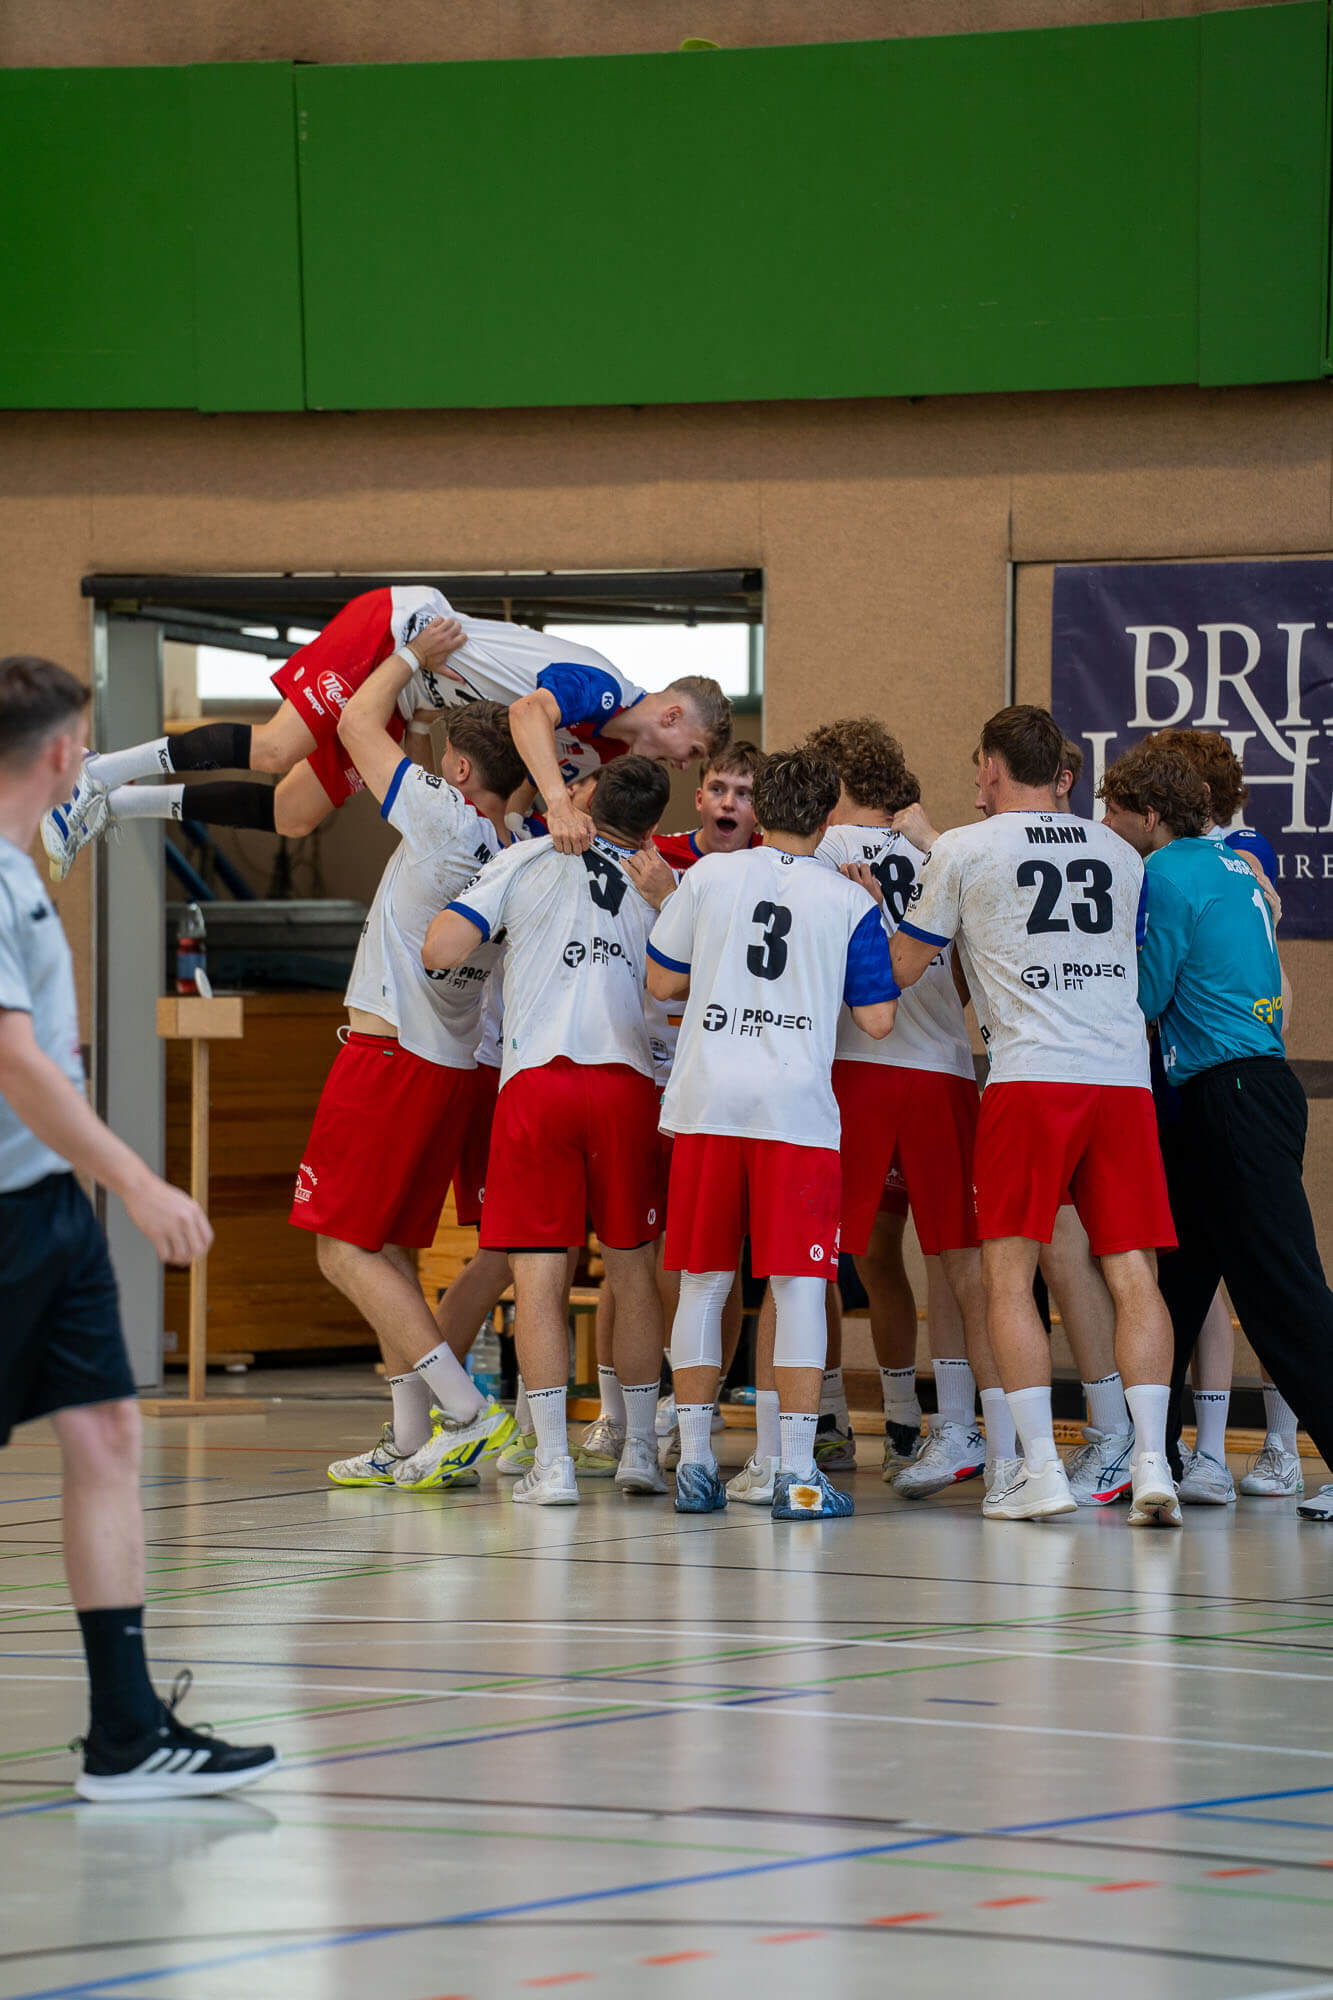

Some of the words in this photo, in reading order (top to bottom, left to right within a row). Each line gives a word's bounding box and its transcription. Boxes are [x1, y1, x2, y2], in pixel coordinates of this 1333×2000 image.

[1125, 622, 1333, 764] BRI
[1024, 826, 1088, 844] MANN
[1016, 858, 1114, 936] 23
[746, 900, 793, 981] 3
[1063, 978, 1085, 991] FIT
[739, 1024, 764, 1038] FIT
